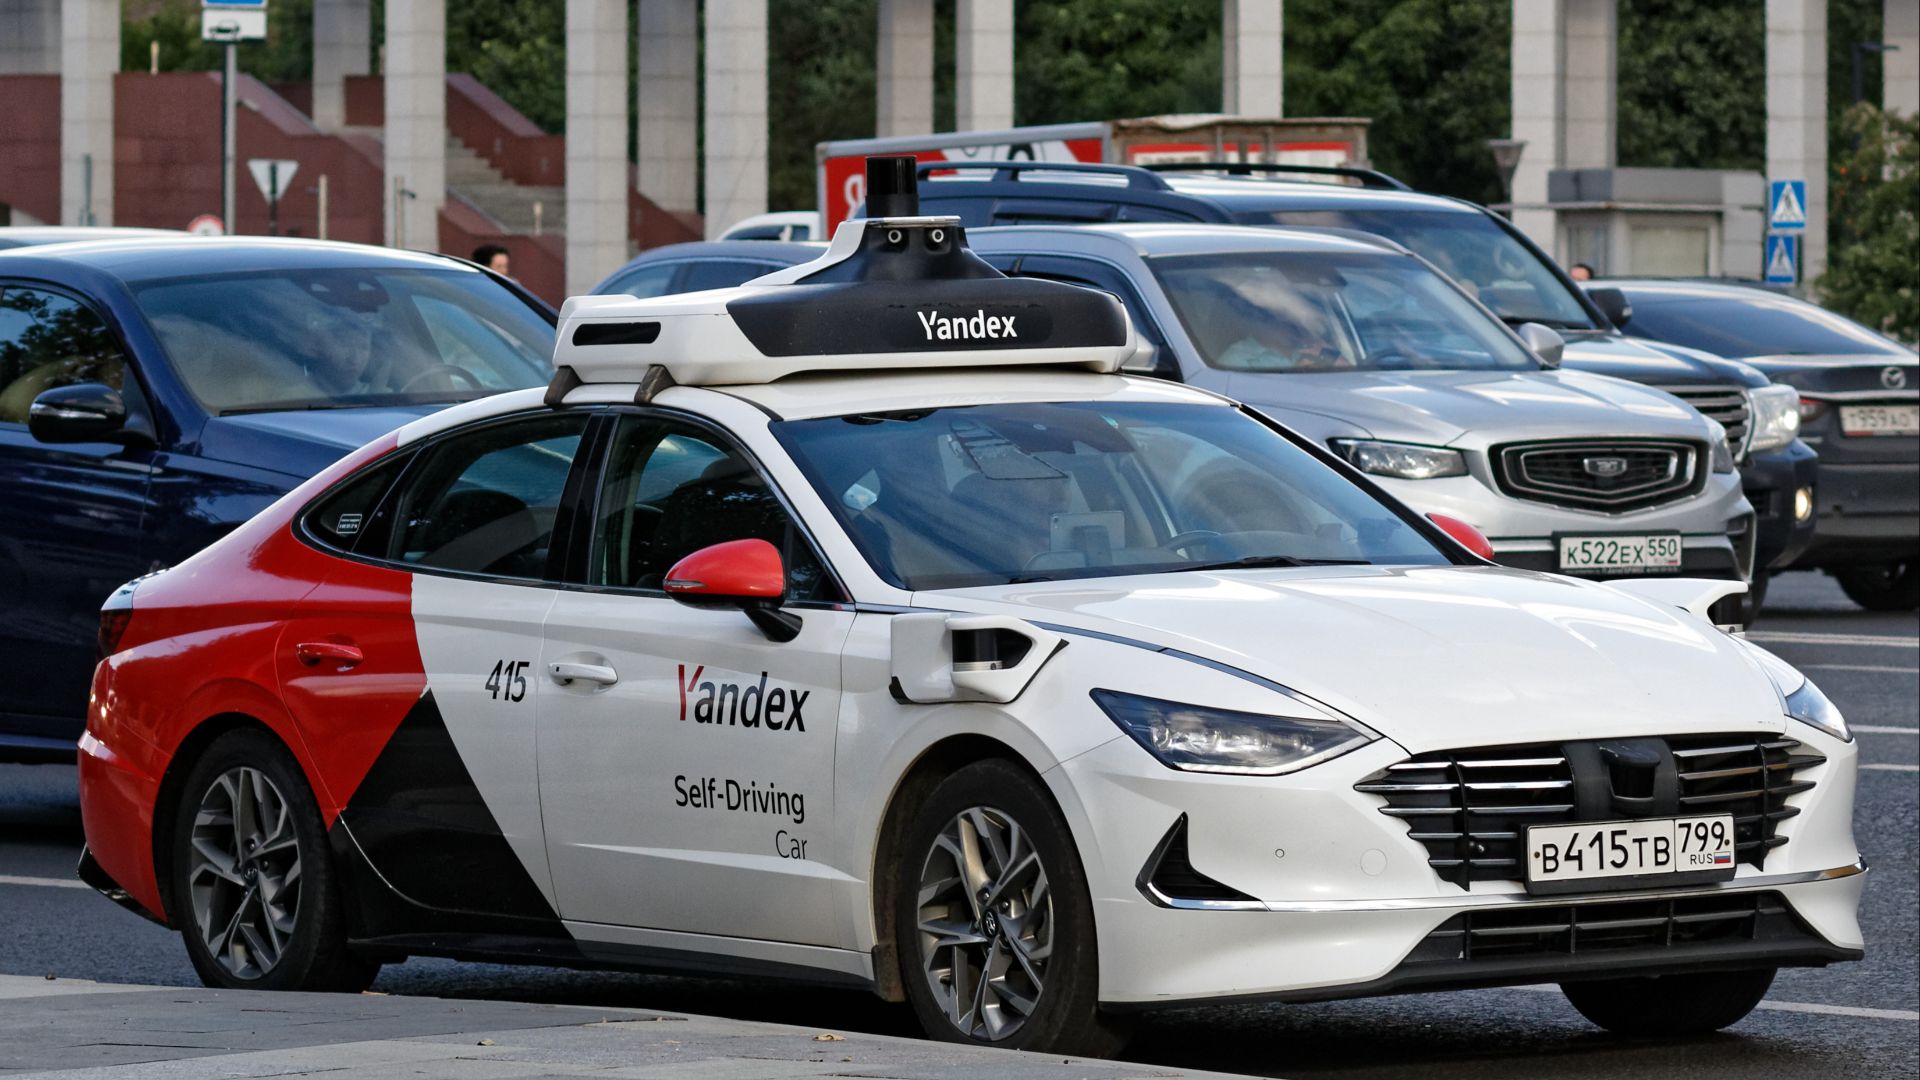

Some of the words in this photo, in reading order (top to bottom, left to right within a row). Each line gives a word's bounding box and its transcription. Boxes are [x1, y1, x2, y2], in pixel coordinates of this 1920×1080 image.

[917, 309, 1018, 340] Yandex
[1648, 538, 1677, 557] 550
[485, 659, 530, 703] 415
[678, 664, 810, 732] Yandex
[674, 774, 805, 824] Self-Driving
[775, 829, 808, 860] Car
[1542, 829, 1670, 874] В415ТВ
[1678, 820, 1725, 853] 799
[1690, 853, 1713, 865] RUS
